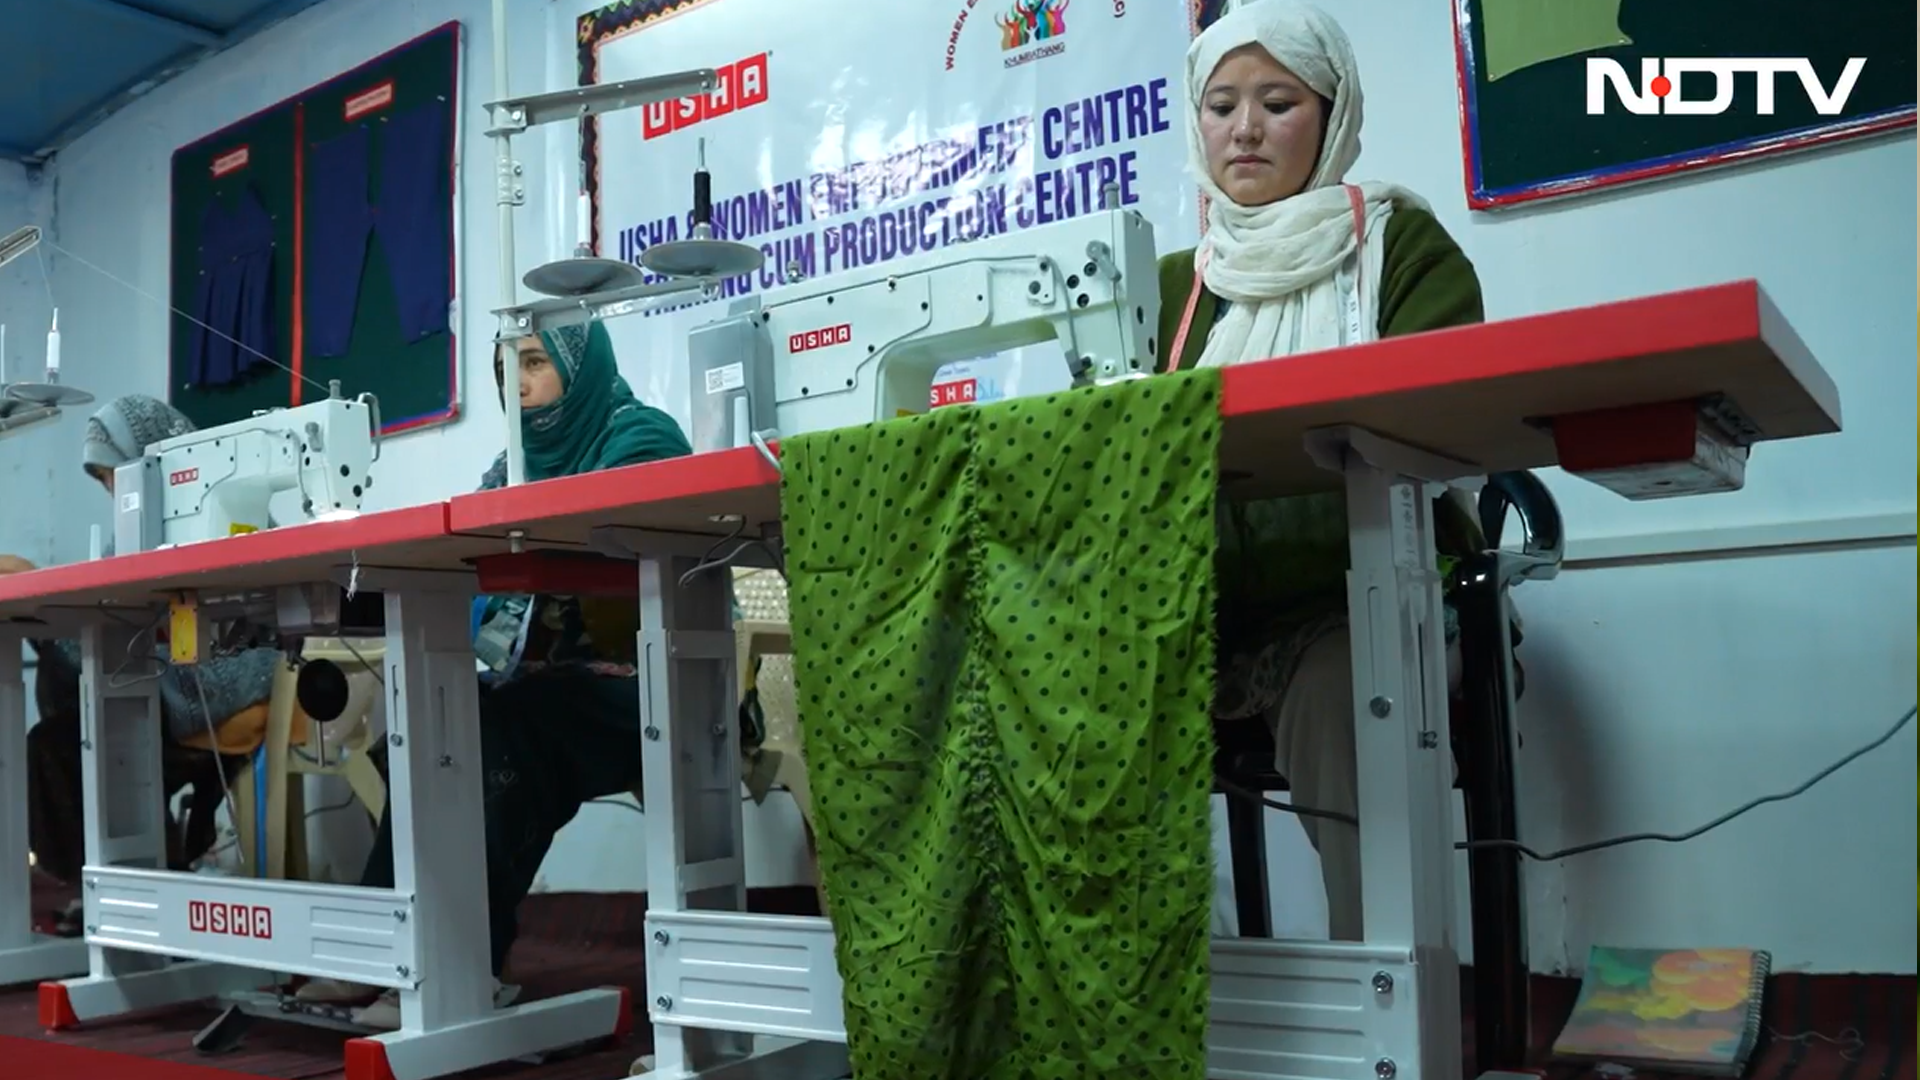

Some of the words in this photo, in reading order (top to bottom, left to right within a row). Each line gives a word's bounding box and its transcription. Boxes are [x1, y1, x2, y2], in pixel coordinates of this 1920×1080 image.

[944, 9, 969, 71] WOMEN
[645, 60, 765, 133] USHA
[709, 179, 803, 241] WOMEN
[1042, 77, 1170, 160] CENTRE
[759, 230, 816, 290] CUM
[823, 183, 1008, 276] PRODUCTION
[1015, 151, 1139, 229] CENTRE
[791, 325, 850, 352] USHA
[929, 381, 976, 405] SHA
[190, 901, 271, 938] USHA
